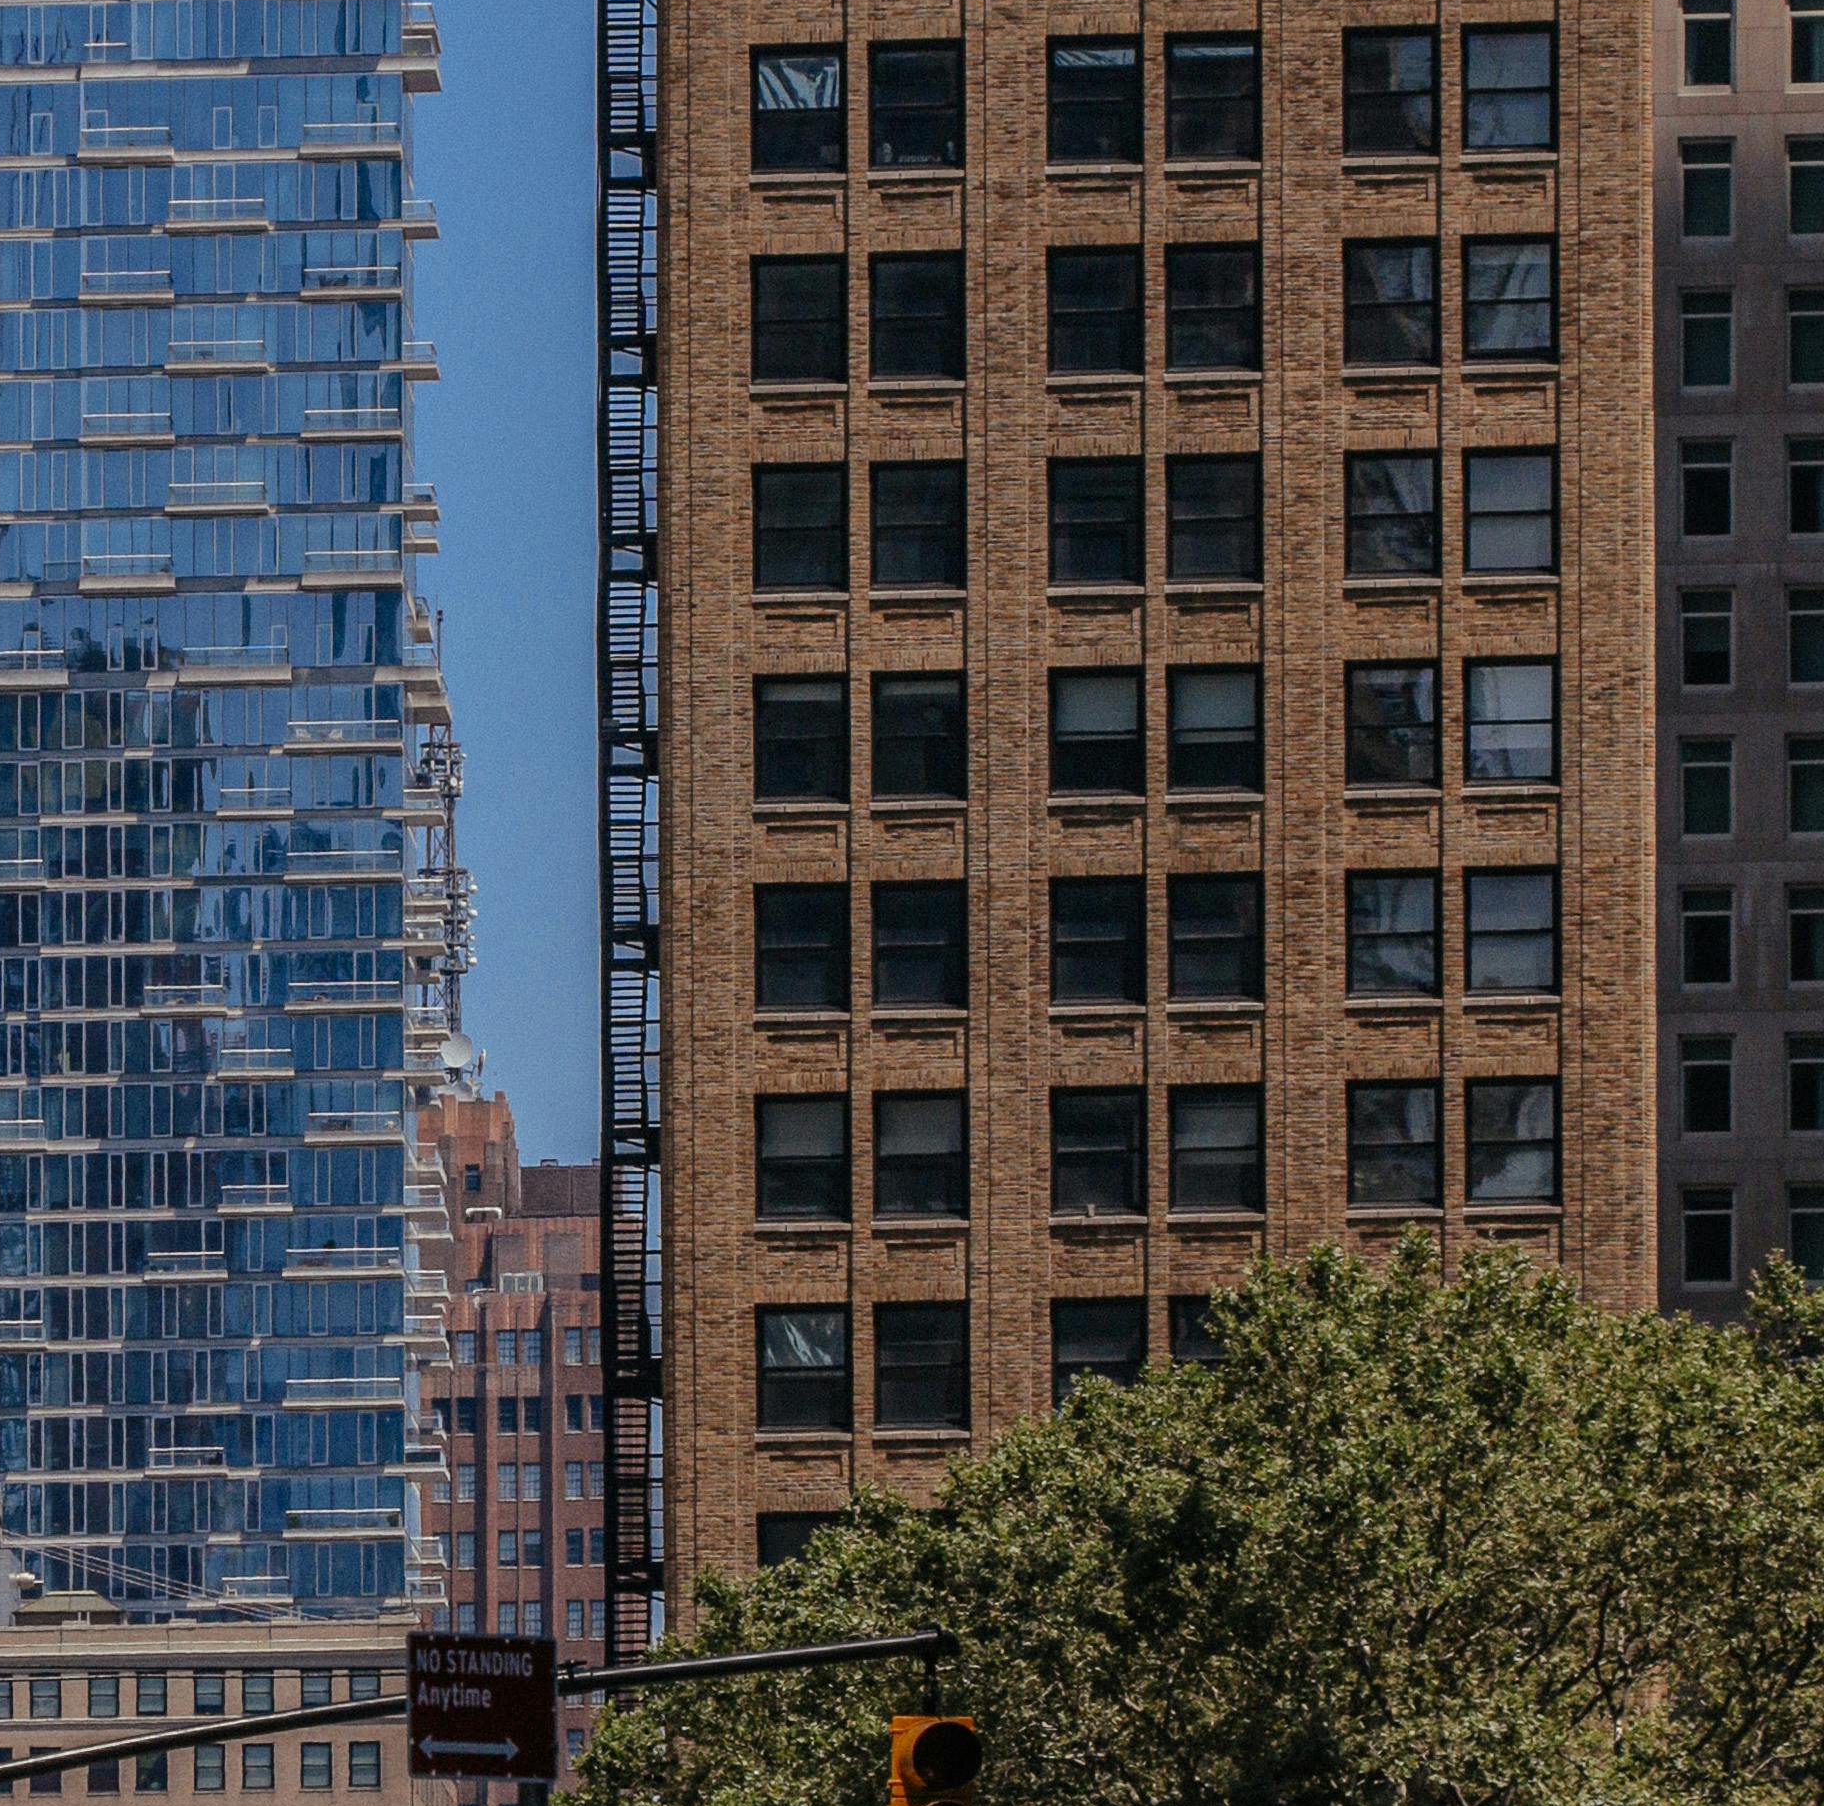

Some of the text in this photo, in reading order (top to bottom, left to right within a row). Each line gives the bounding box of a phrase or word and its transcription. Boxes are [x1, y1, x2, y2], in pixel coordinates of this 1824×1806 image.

[416, 1649, 533, 1677] NO STANDING
[417, 1682, 492, 1711] Anytime
